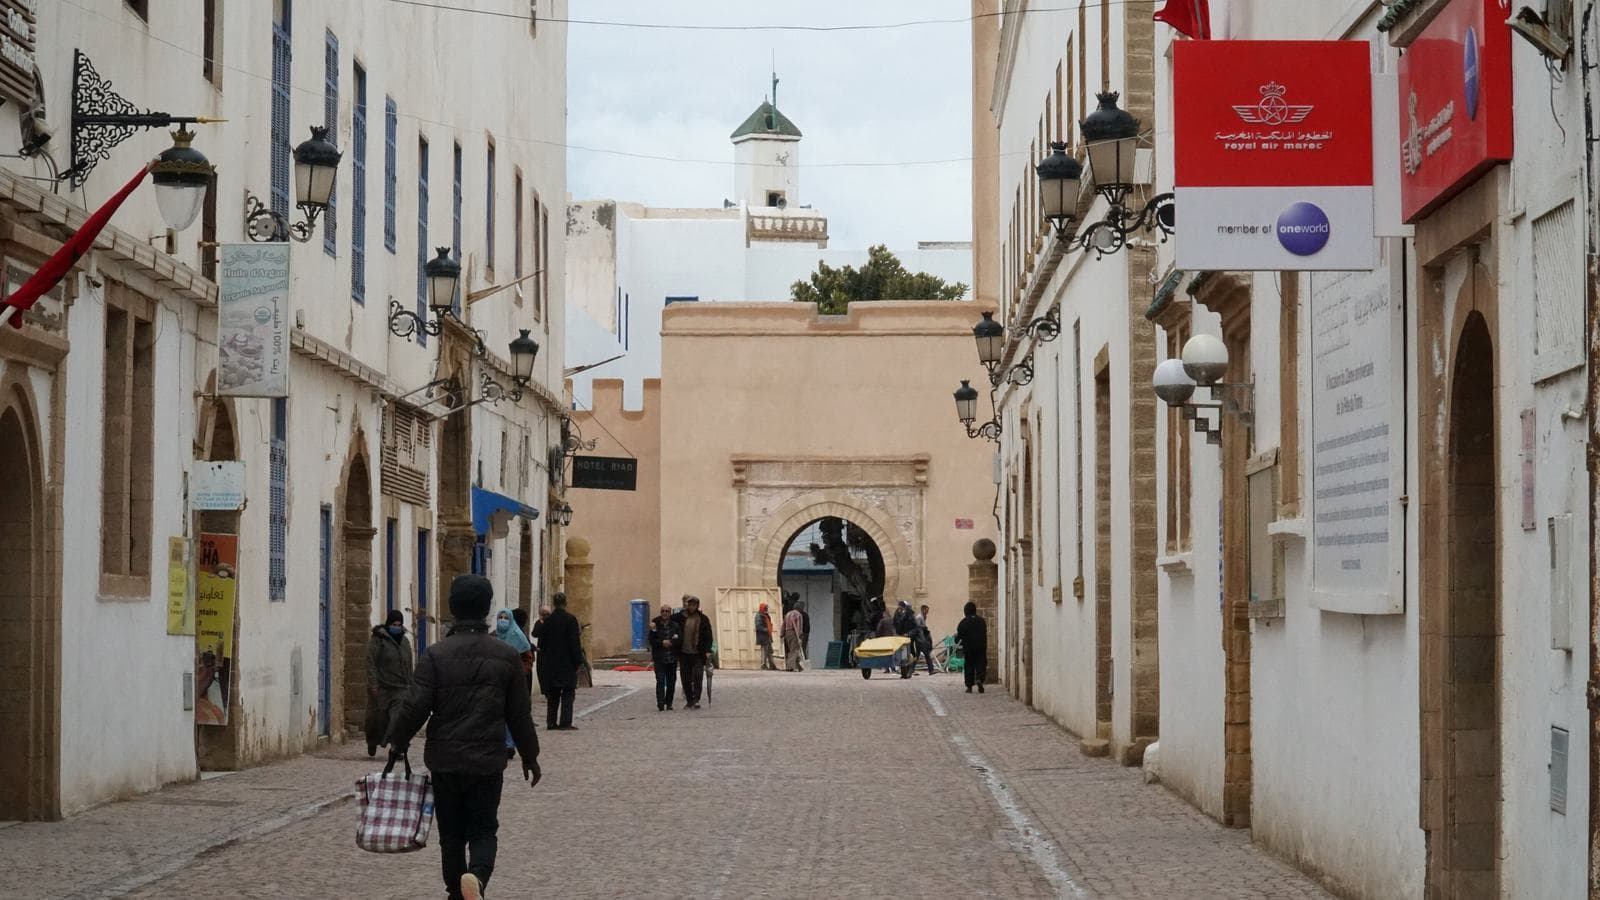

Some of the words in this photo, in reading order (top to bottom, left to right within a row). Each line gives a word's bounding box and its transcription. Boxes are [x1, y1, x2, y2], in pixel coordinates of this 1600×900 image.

[1217, 224, 1259, 234] member
[1262, 224, 1272, 234] of
[1280, 223, 1328, 233] oneworld
[272, 331, 282, 355] 100%
[576, 460, 606, 471] HOTEL
[611, 462, 633, 472] RIAD
